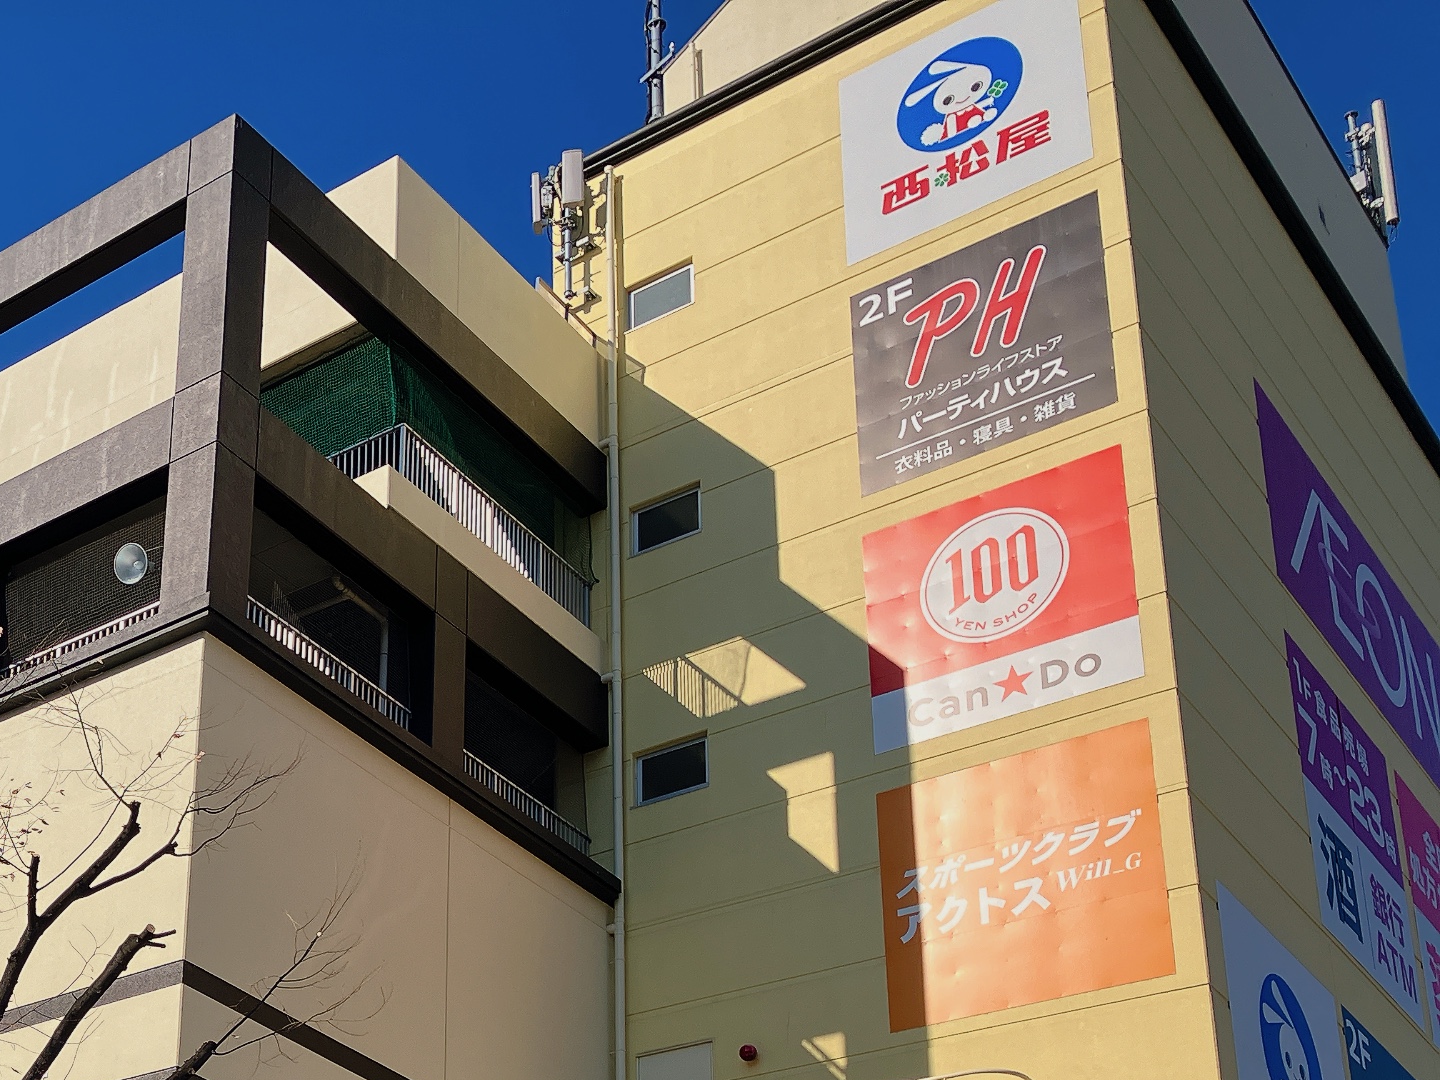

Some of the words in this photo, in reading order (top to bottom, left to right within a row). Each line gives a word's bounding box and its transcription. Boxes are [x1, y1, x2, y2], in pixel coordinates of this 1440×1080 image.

[880, 110, 1052, 216] 西松屋
[858, 278, 915, 328] 2F
[903, 244, 1048, 389] PH
[897, 356, 1069, 440] パーティハウス
[899, 334, 1063, 410] ファッションライフストア
[894, 392, 1077, 475] 衣料品・寝具・雑貨
[945, 524, 1040, 618] 100
[954, 616, 987, 632] YEN
[992, 592, 1038, 630] SHOP
[896, 809, 1143, 898] スポーツクラブ
[1317, 813, 1364, 944] 酒
[1409, 846, 1440, 909] 処方
[896, 878, 1051, 944] アクトス
[1369, 873, 1405, 948] 銀行
[1377, 930, 1418, 1004] ATM
[1345, 1018, 1373, 1070] 2F
